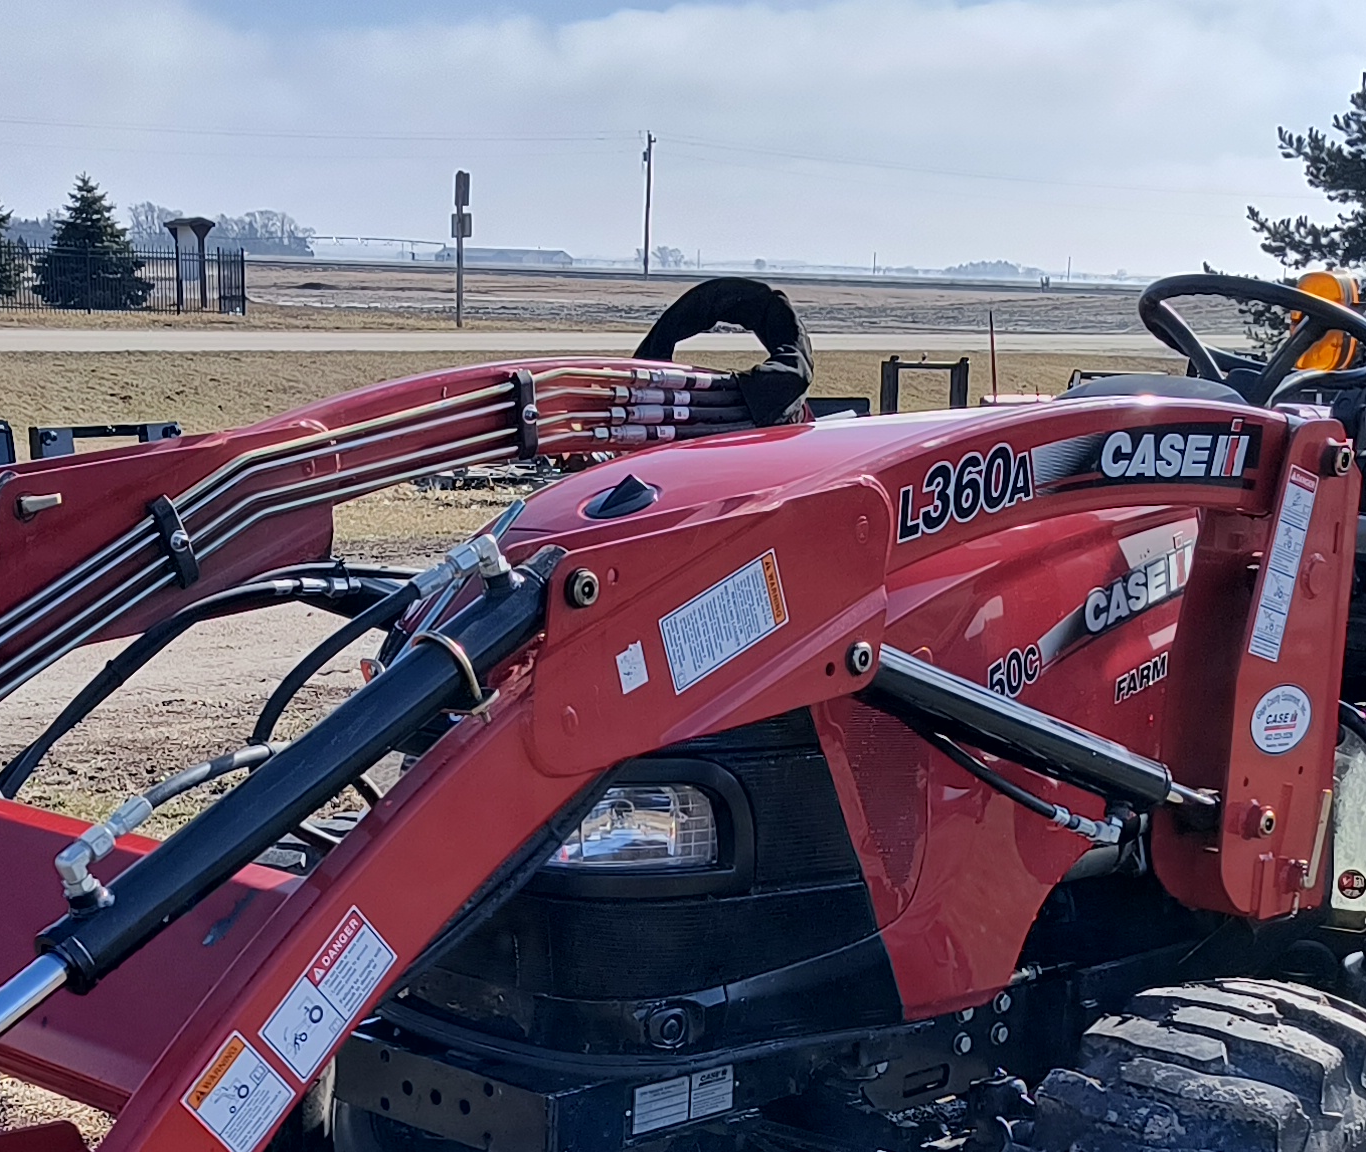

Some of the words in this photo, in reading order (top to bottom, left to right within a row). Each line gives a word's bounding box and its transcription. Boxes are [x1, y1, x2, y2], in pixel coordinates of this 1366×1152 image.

[768, 572, 783, 618] WARNING
[1114, 651, 1169, 705] FARM
[321, 918, 359, 967] DANGER
[203, 1046, 238, 1090] WARNING
